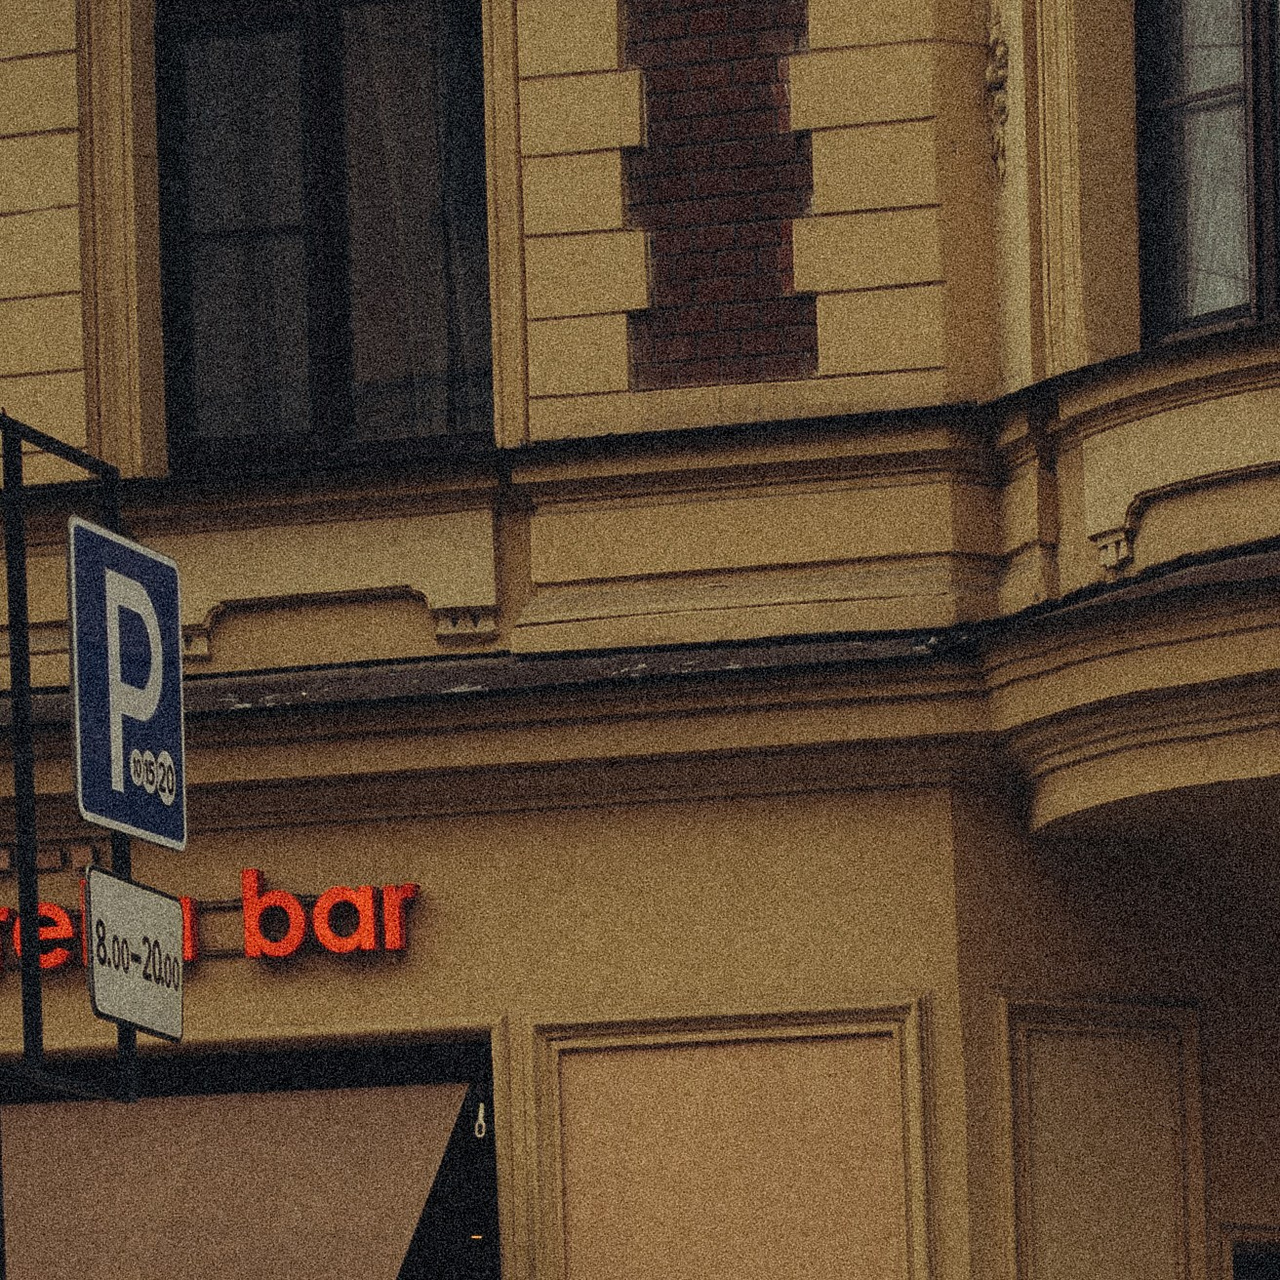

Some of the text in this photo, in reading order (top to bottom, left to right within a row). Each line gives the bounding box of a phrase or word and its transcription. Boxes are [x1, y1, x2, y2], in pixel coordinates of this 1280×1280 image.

[105, 567, 163, 793] P
[144, 759, 155, 786] 15
[158, 761, 175, 796] 20
[241, 867, 420, 958] bar
